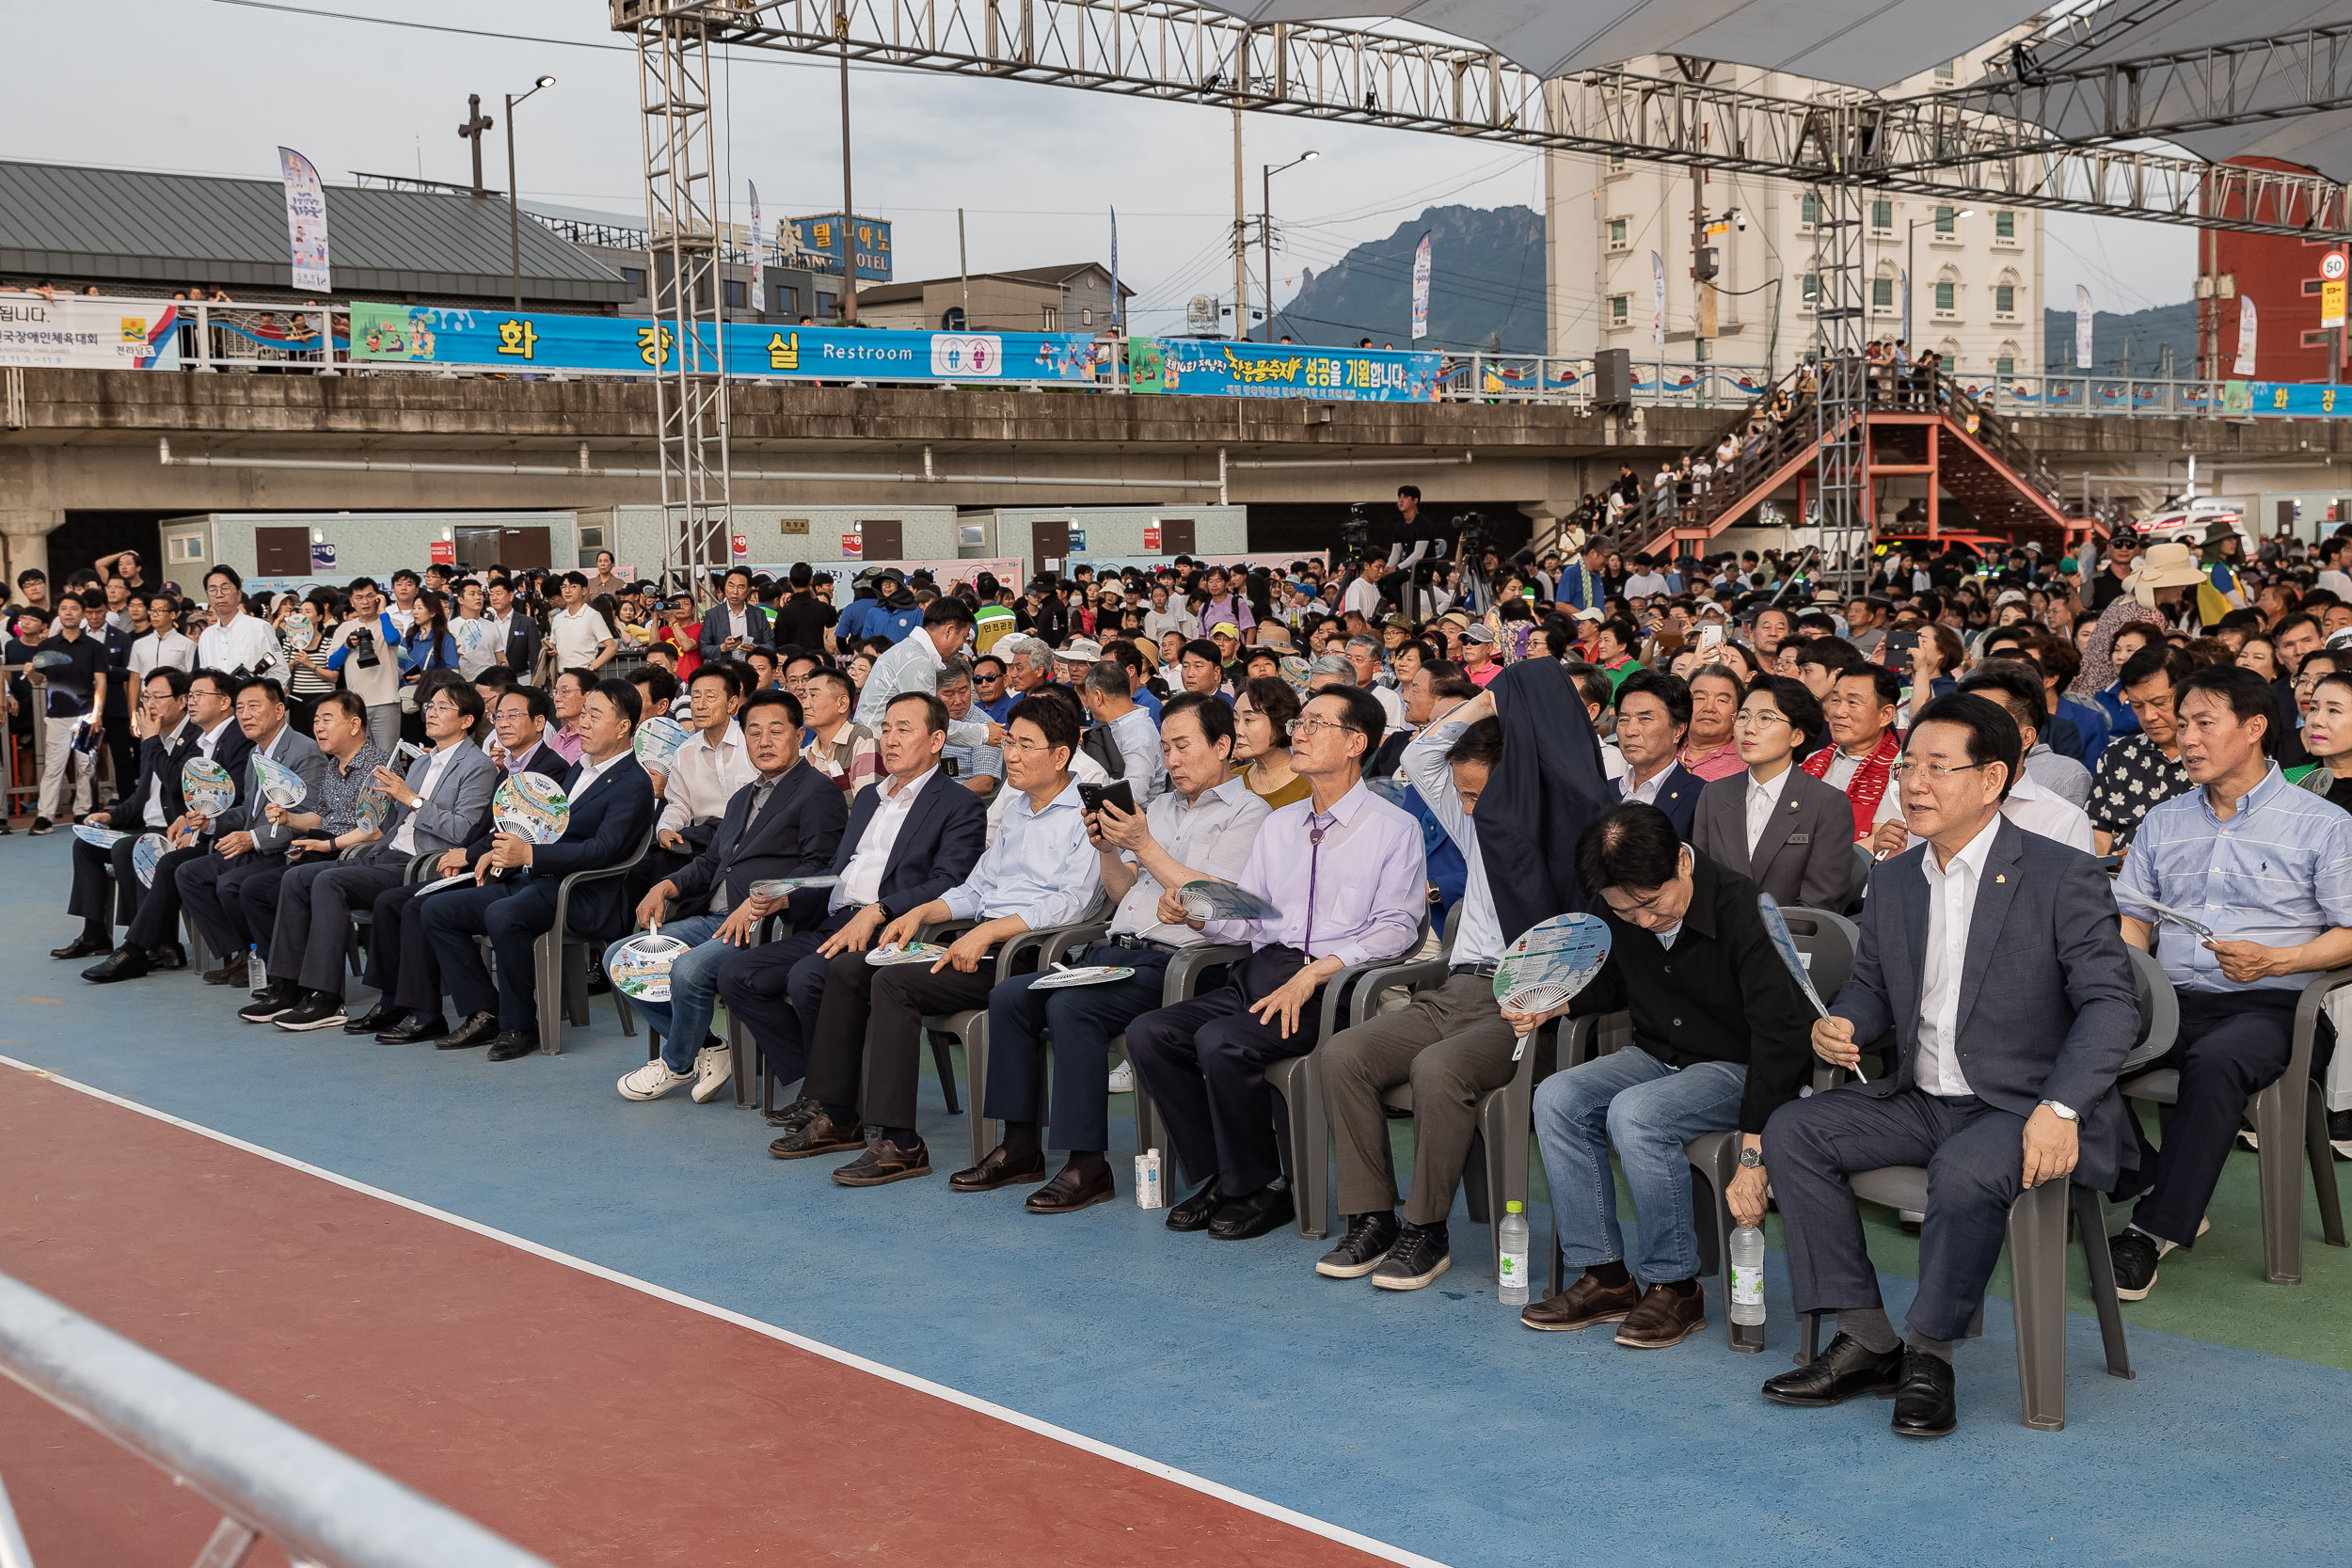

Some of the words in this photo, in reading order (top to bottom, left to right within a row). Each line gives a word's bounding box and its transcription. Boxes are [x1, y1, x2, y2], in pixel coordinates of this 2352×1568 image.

[2326, 261, 2342, 273] 50
[498, 318, 538, 361] 화
[766, 332, 799, 370] 실
[823, 342, 913, 361] Restroom
[1166, 357, 1196, 373] 제16회
[1198, 357, 1227, 374] 정남진
[1223, 344, 1304, 383] 장흥물축제
[1305, 356, 1343, 388] 성공을
[2273, 388, 2289, 411] 화
[2321, 388, 2336, 413] 장
[983, 621, 1012, 633] 안전관리
